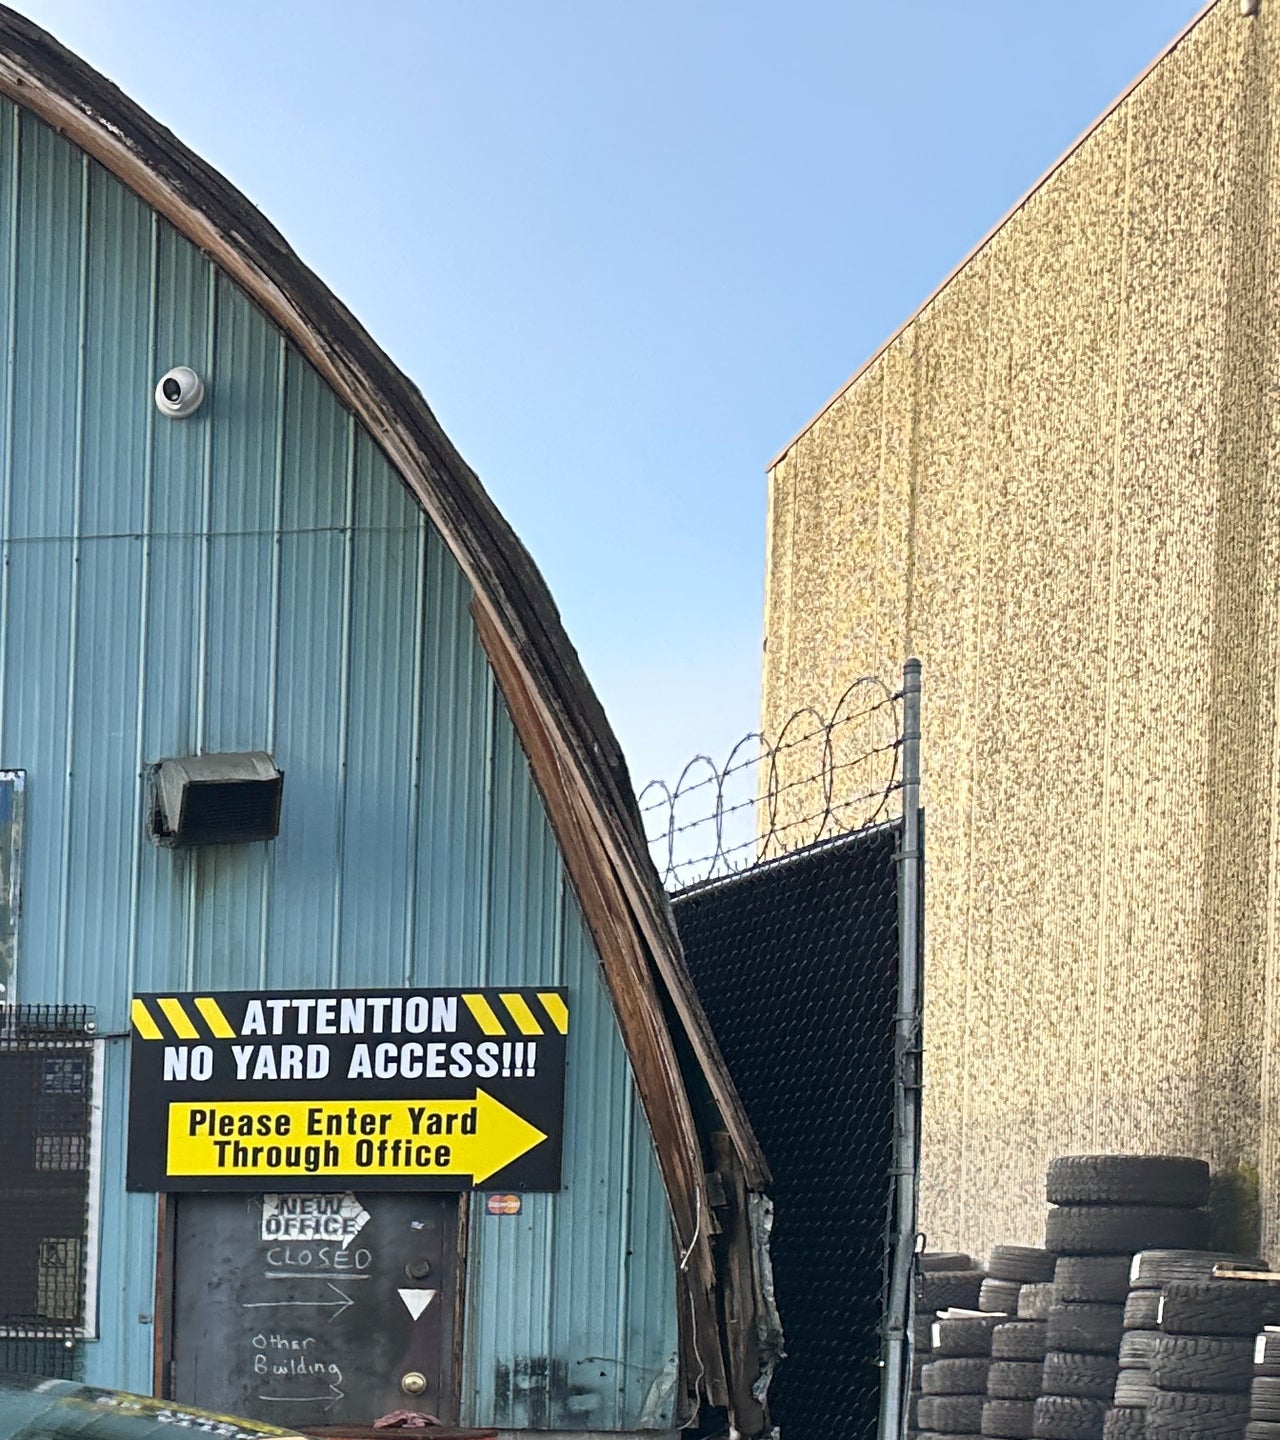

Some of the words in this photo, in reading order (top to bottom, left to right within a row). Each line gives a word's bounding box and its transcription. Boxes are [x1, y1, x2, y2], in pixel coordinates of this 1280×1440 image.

[241, 996, 458, 1036] ATTENTION
[163, 1045, 214, 1081] NO
[231, 1045, 330, 1080] YARD
[347, 1041, 537, 1078] ACCESS!!!
[188, 1108, 290, 1137] Please
[307, 1107, 392, 1135] Enter
[407, 1106, 477, 1135] Yard
[213, 1140, 340, 1172] Through
[355, 1141, 451, 1167] Office
[277, 1199, 341, 1217] NEW
[266, 1215, 357, 1237] OFFICE
[267, 1247, 372, 1269] CLOSED
[252, 1333, 316, 1350] Other
[255, 1355, 342, 1385] Building
